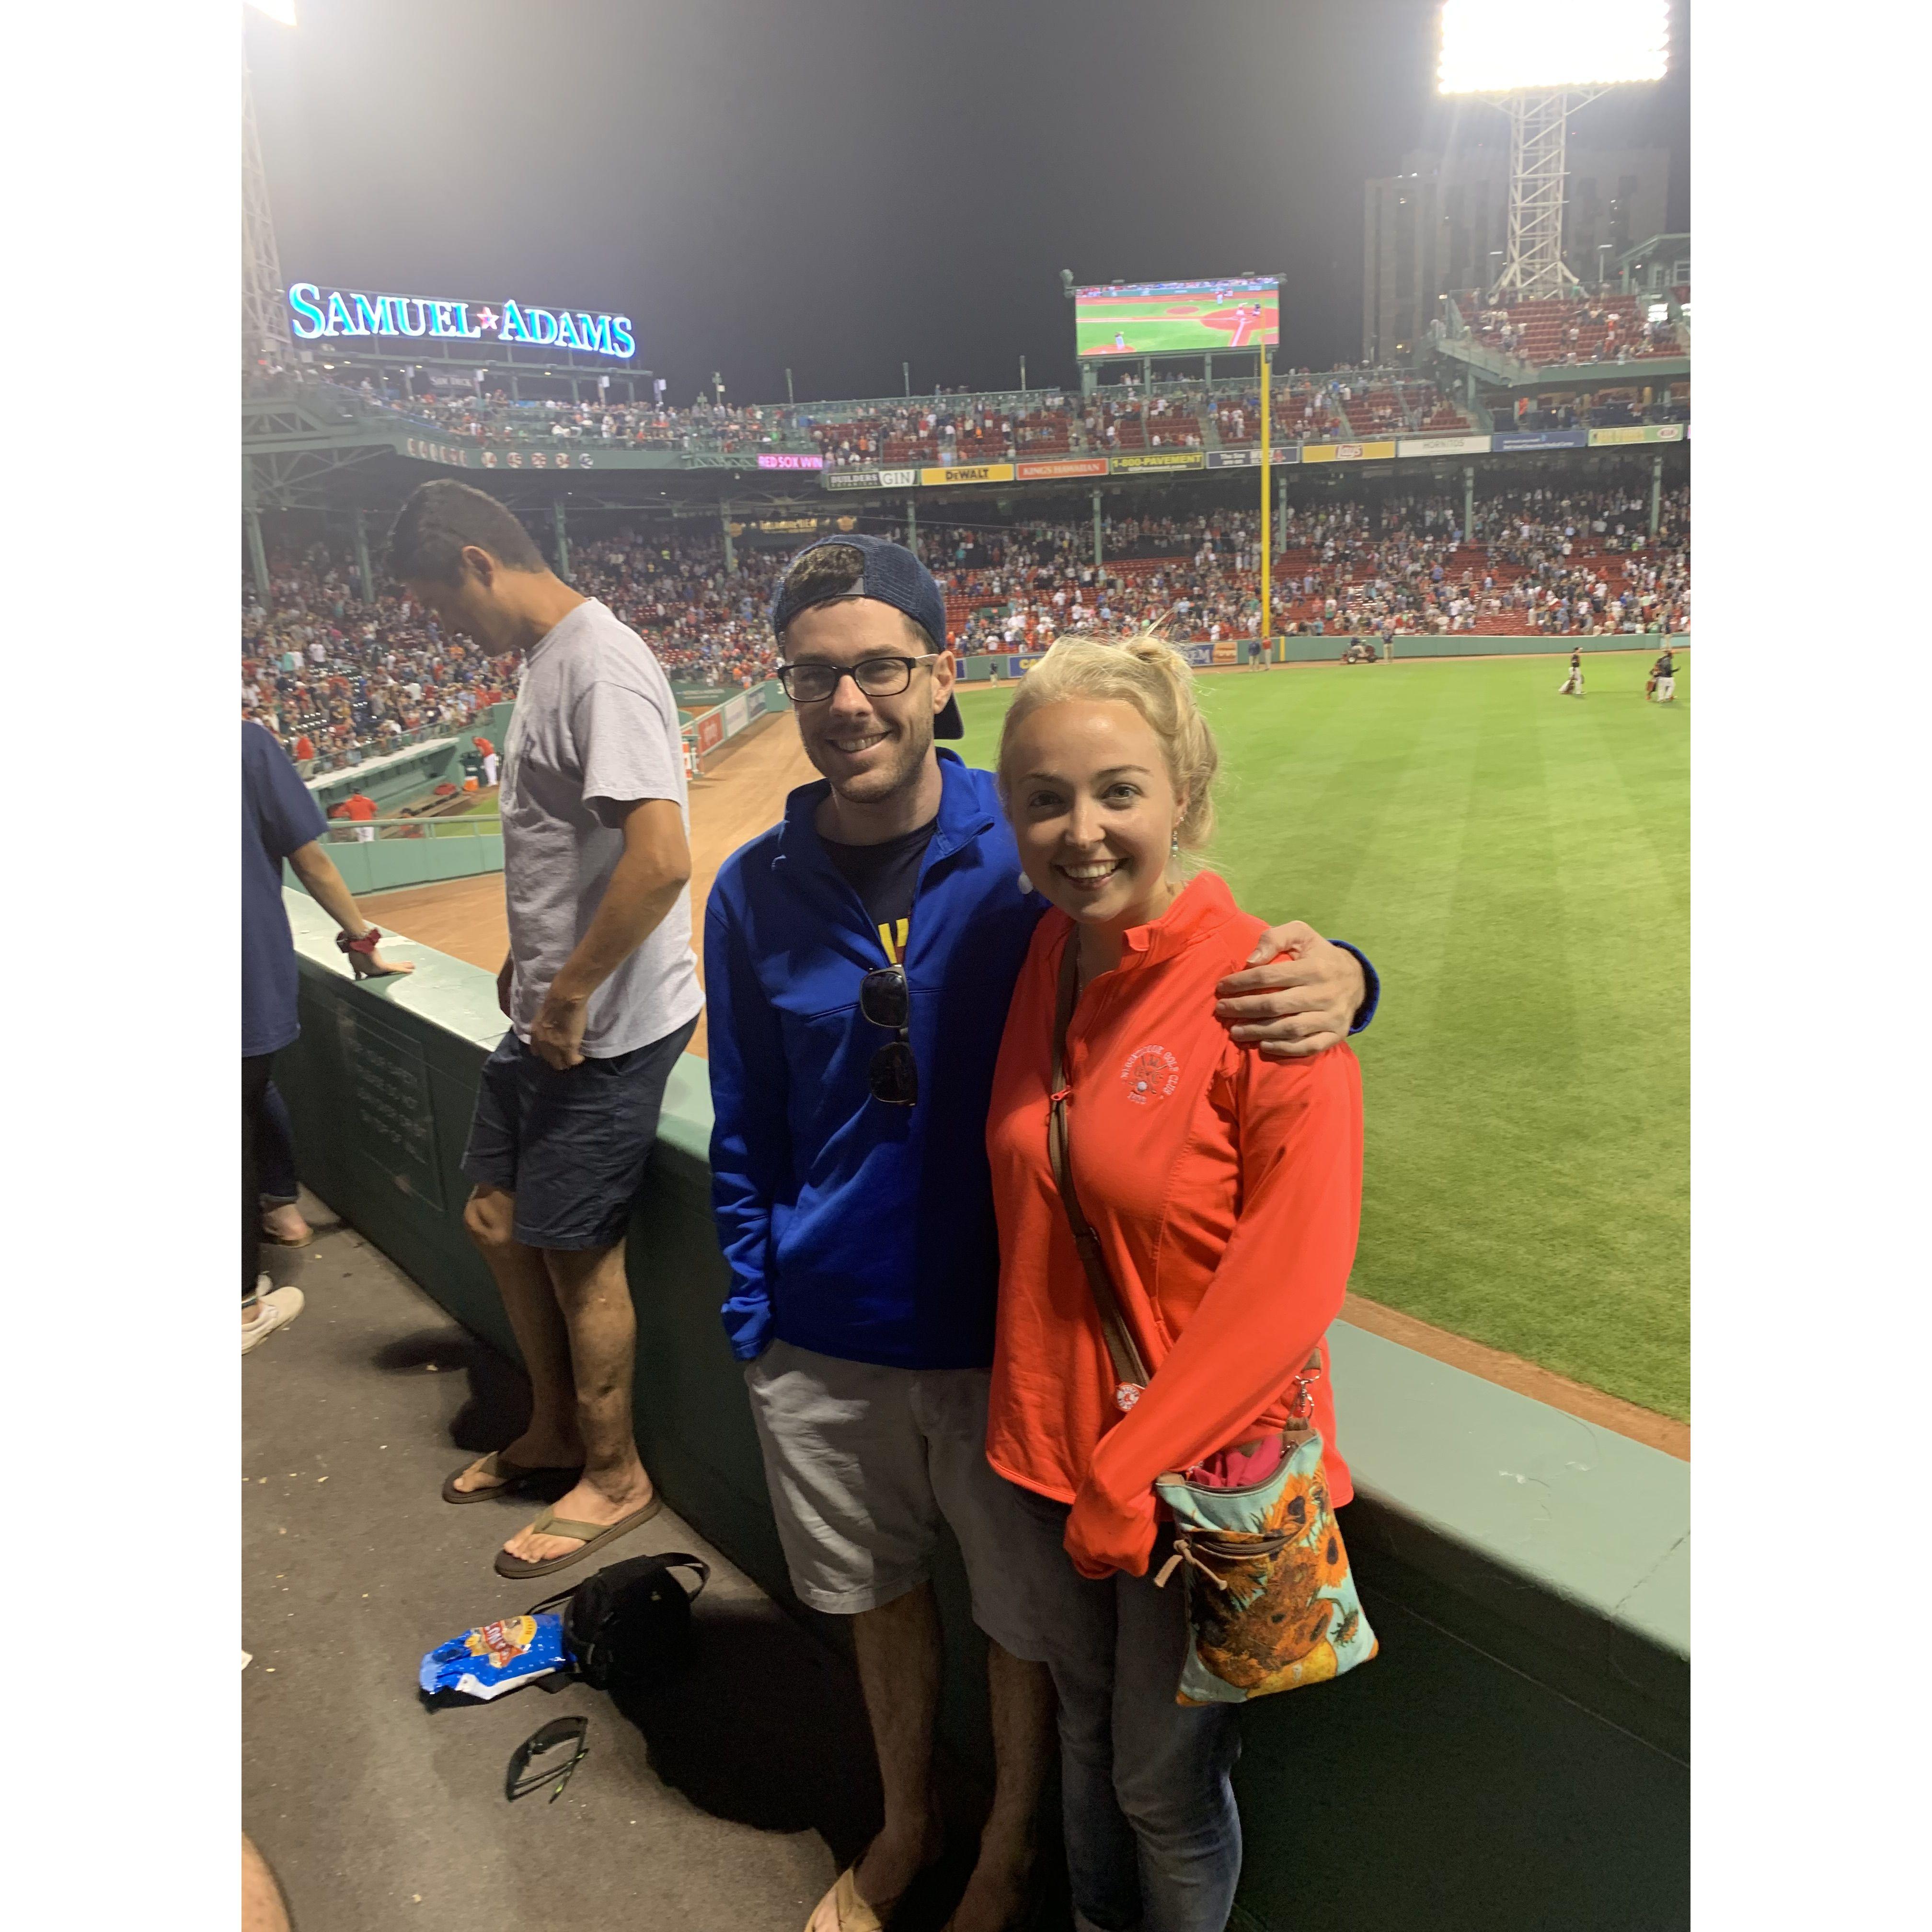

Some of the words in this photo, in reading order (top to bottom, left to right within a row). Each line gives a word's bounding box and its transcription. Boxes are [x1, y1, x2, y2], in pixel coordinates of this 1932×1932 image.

[288, 282, 481, 339] SAMUEL
[497, 299, 636, 358] ADAMS
[759, 456, 777, 468] RED
[778, 456, 799, 468] SOX
[800, 457, 823, 468] WIN
[1112, 455, 1202, 468] 1-800-PAVEMENT
[882, 472, 911, 485] GIN
[1162, 1074, 1179, 1095] CLUB
